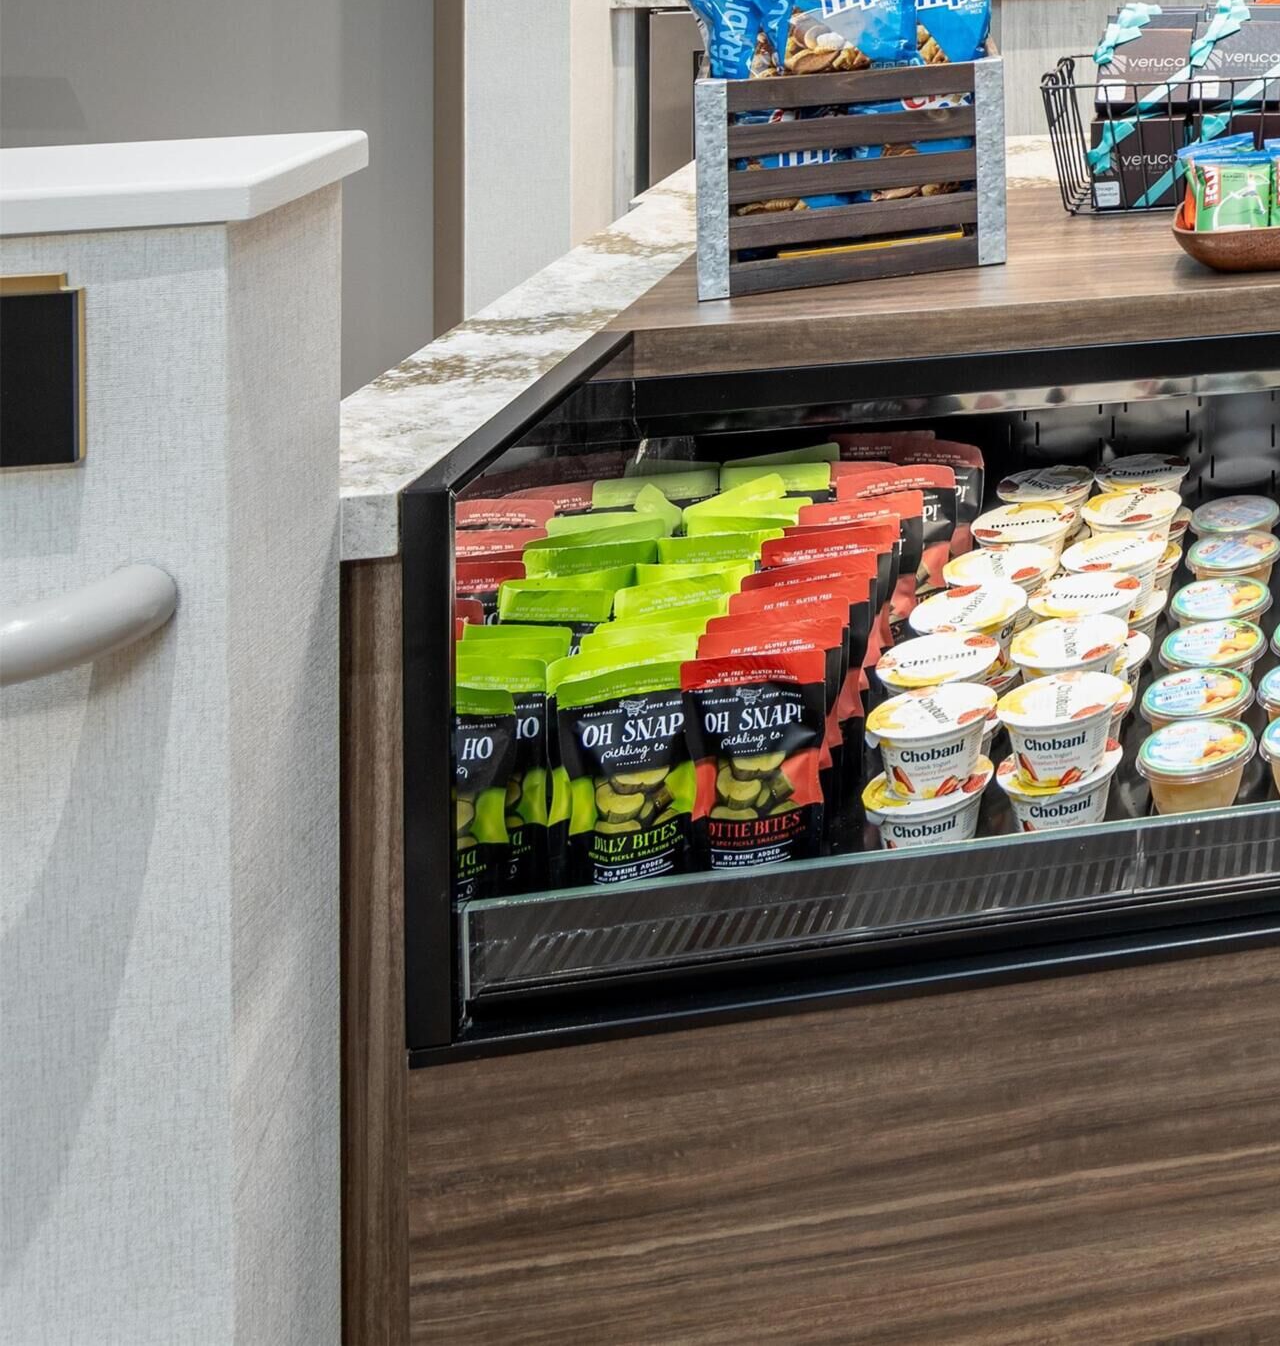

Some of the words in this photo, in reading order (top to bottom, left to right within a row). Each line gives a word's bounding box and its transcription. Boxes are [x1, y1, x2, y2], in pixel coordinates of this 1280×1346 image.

[1128, 55, 1187, 69] veruca
[1225, 50, 1280, 64] veruca
[1111, 465, 1173, 478] Chobani
[1052, 590, 1120, 600] Chobani
[900, 648, 977, 670] Chobani
[704, 711, 729, 734] OH
[738, 703, 803, 731] SNAP!
[582, 722, 612, 748] OH
[622, 711, 685, 744] SNAP
[720, 733, 767, 749] pickling
[901, 739, 965, 763] Chobani
[1024, 731, 1087, 751] Chobani
[600, 744, 650, 764] pickling
[1030, 794, 1091, 819] Chobani
[594, 834, 628, 852] DILLY
[633, 821, 677, 848] BITES
[893, 816, 957, 839] Chobani
